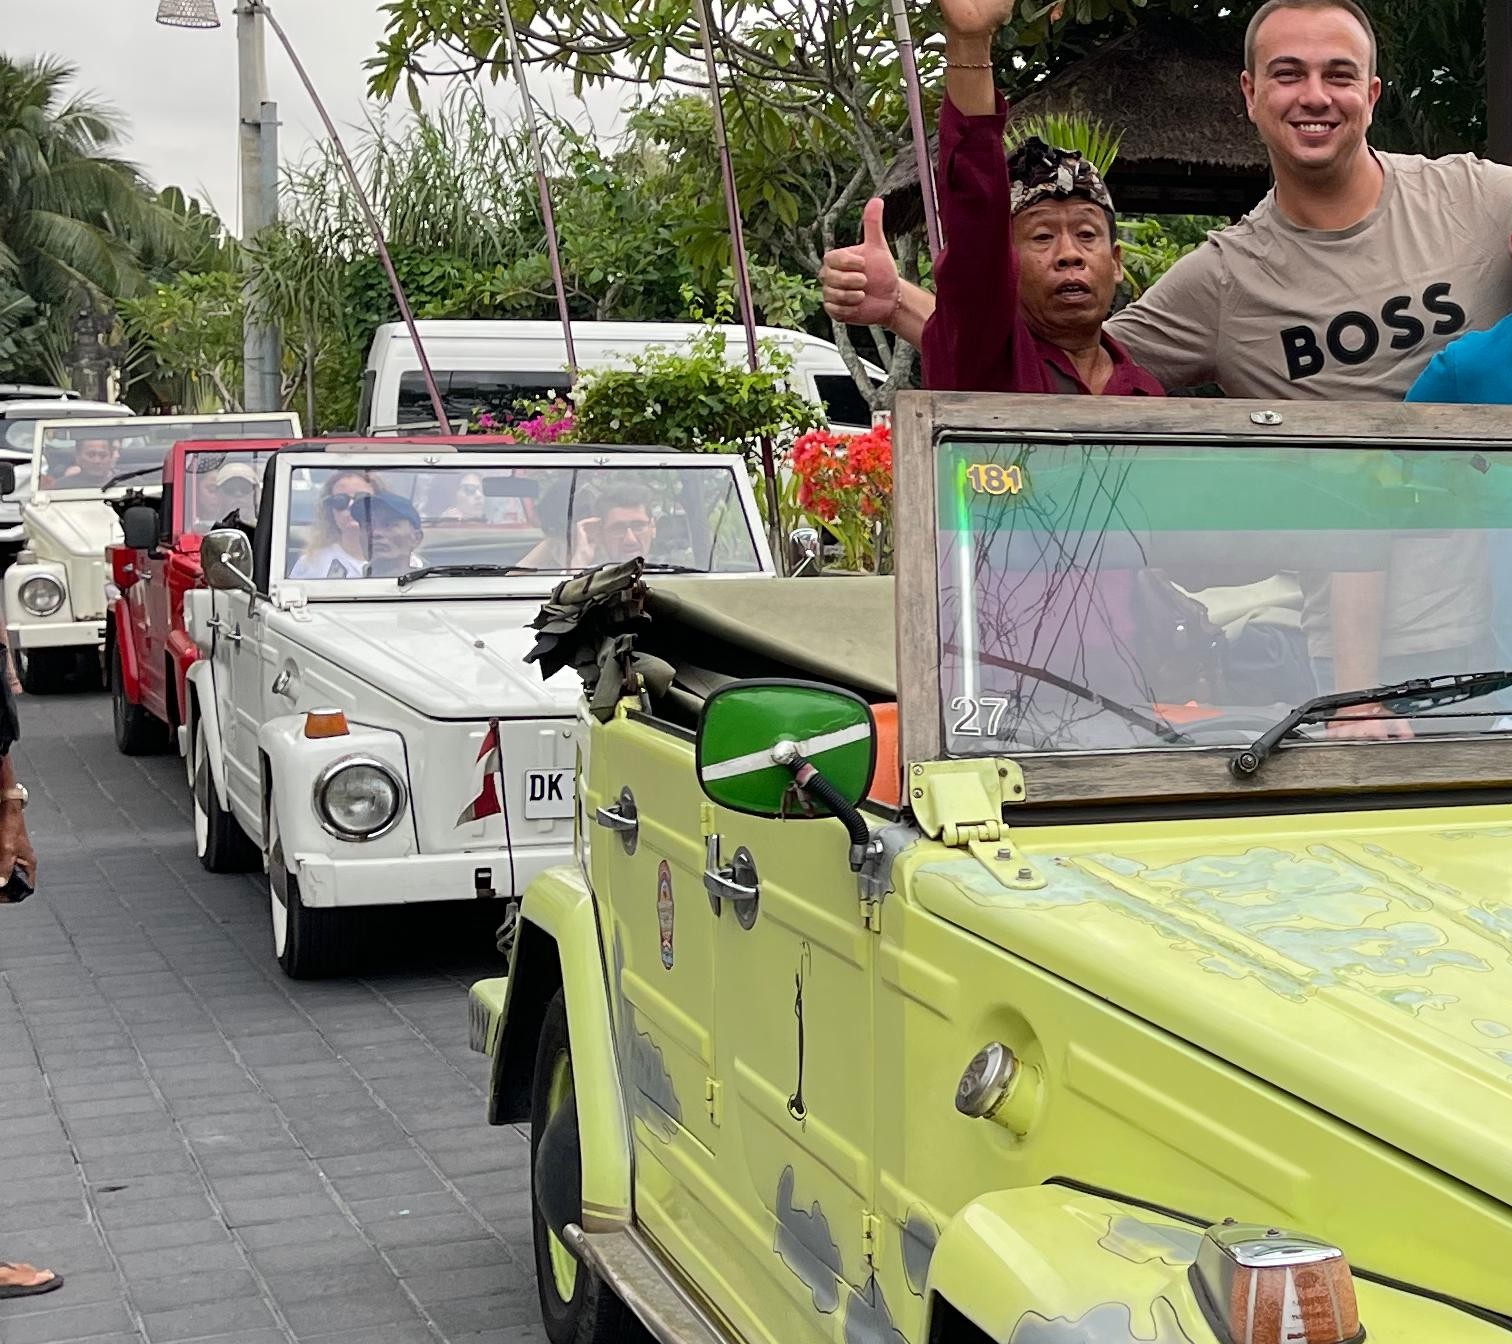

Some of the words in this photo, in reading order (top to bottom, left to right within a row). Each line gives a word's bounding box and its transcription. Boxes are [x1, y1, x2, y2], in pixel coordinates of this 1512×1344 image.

[1280, 281, 1467, 381] BOSS
[967, 463, 1023, 495] 181
[950, 695, 1009, 736] 27
[529, 773, 564, 802] DK
